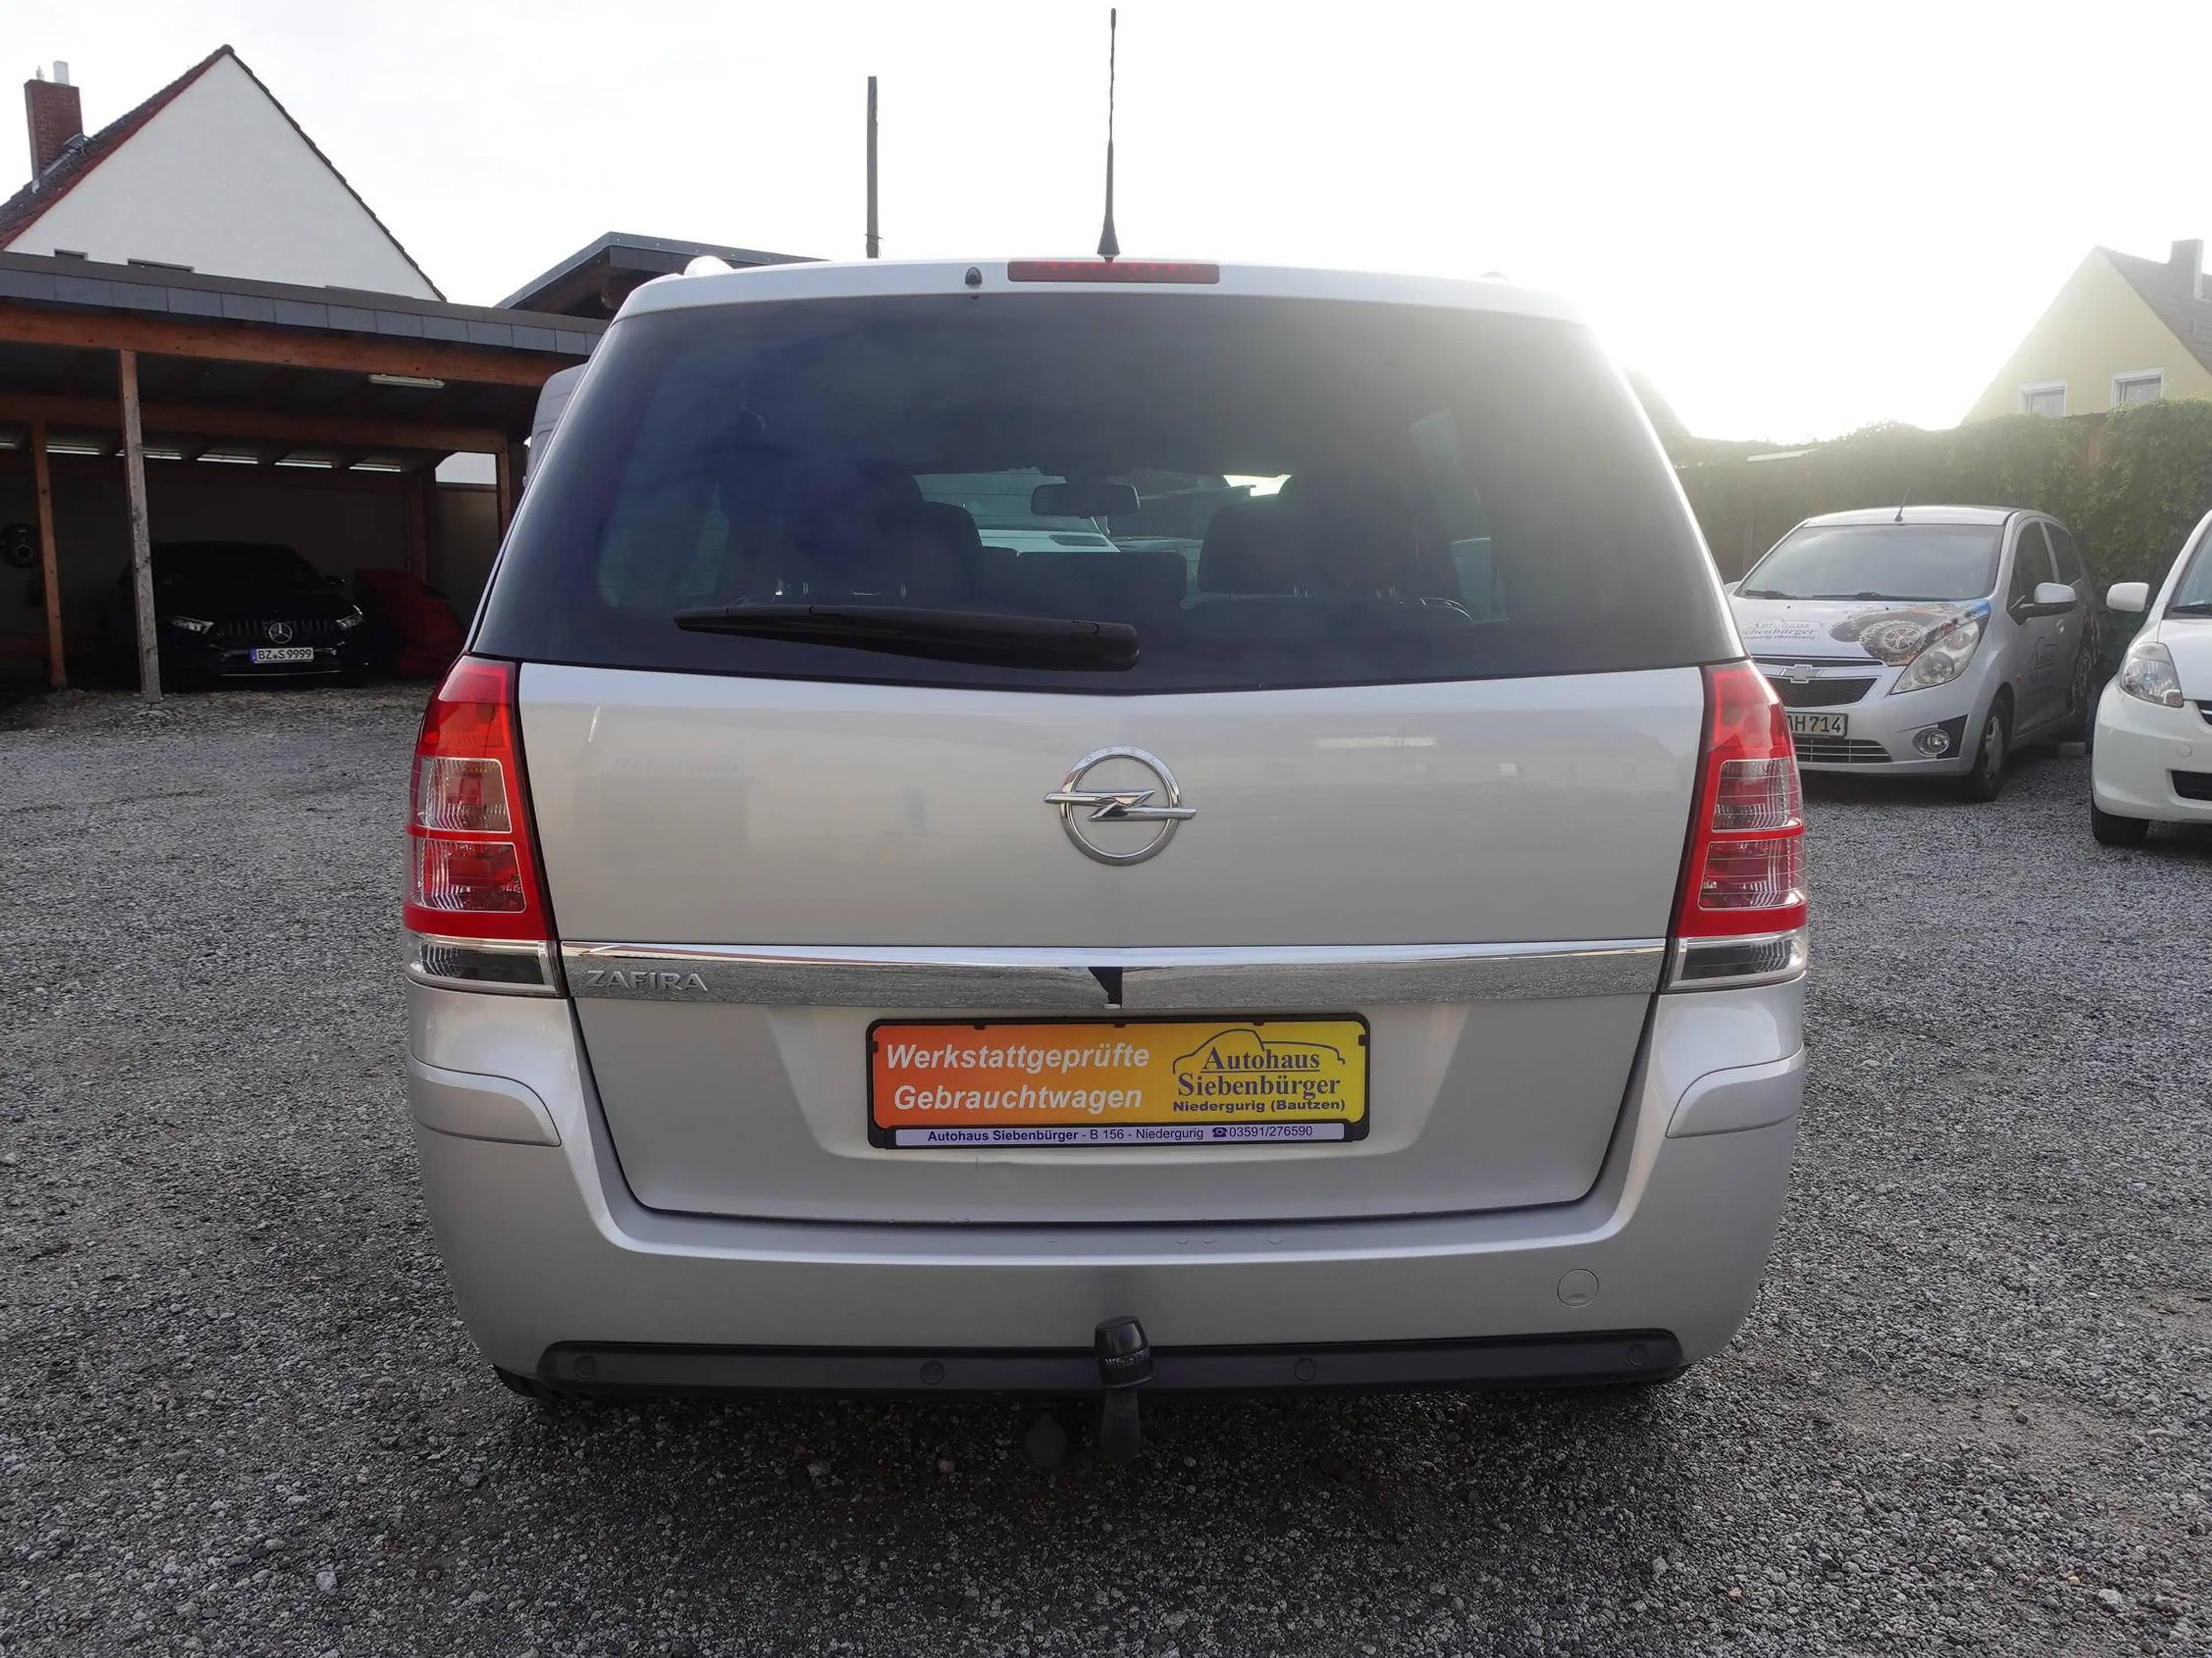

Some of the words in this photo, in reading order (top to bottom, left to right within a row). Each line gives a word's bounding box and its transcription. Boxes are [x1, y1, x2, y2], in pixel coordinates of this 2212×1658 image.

[1810, 715, 1841, 733] 714
[586, 969, 709, 992] ZAFIRA
[887, 1042, 1150, 1075] Werkstattgeprüfte
[1202, 1046, 1320, 1070] Autohaus
[1177, 1072, 1341, 1101] Siebenbürger
[894, 1084, 1143, 1115] Gebrauchtwagen
[1172, 1100, 1266, 1113] Niedergurig
[1270, 1099, 1346, 1113] (Bautzen)
[927, 1130, 990, 1142] Autohaus
[993, 1129, 1079, 1143] Siebenbürger
[1090, 1130, 1098, 1139] B
[1103, 1129, 1124, 1139] 156
[1136, 1127, 1204, 1141] Niedergurig
[1229, 1125, 1313, 1138] 03591/276590
